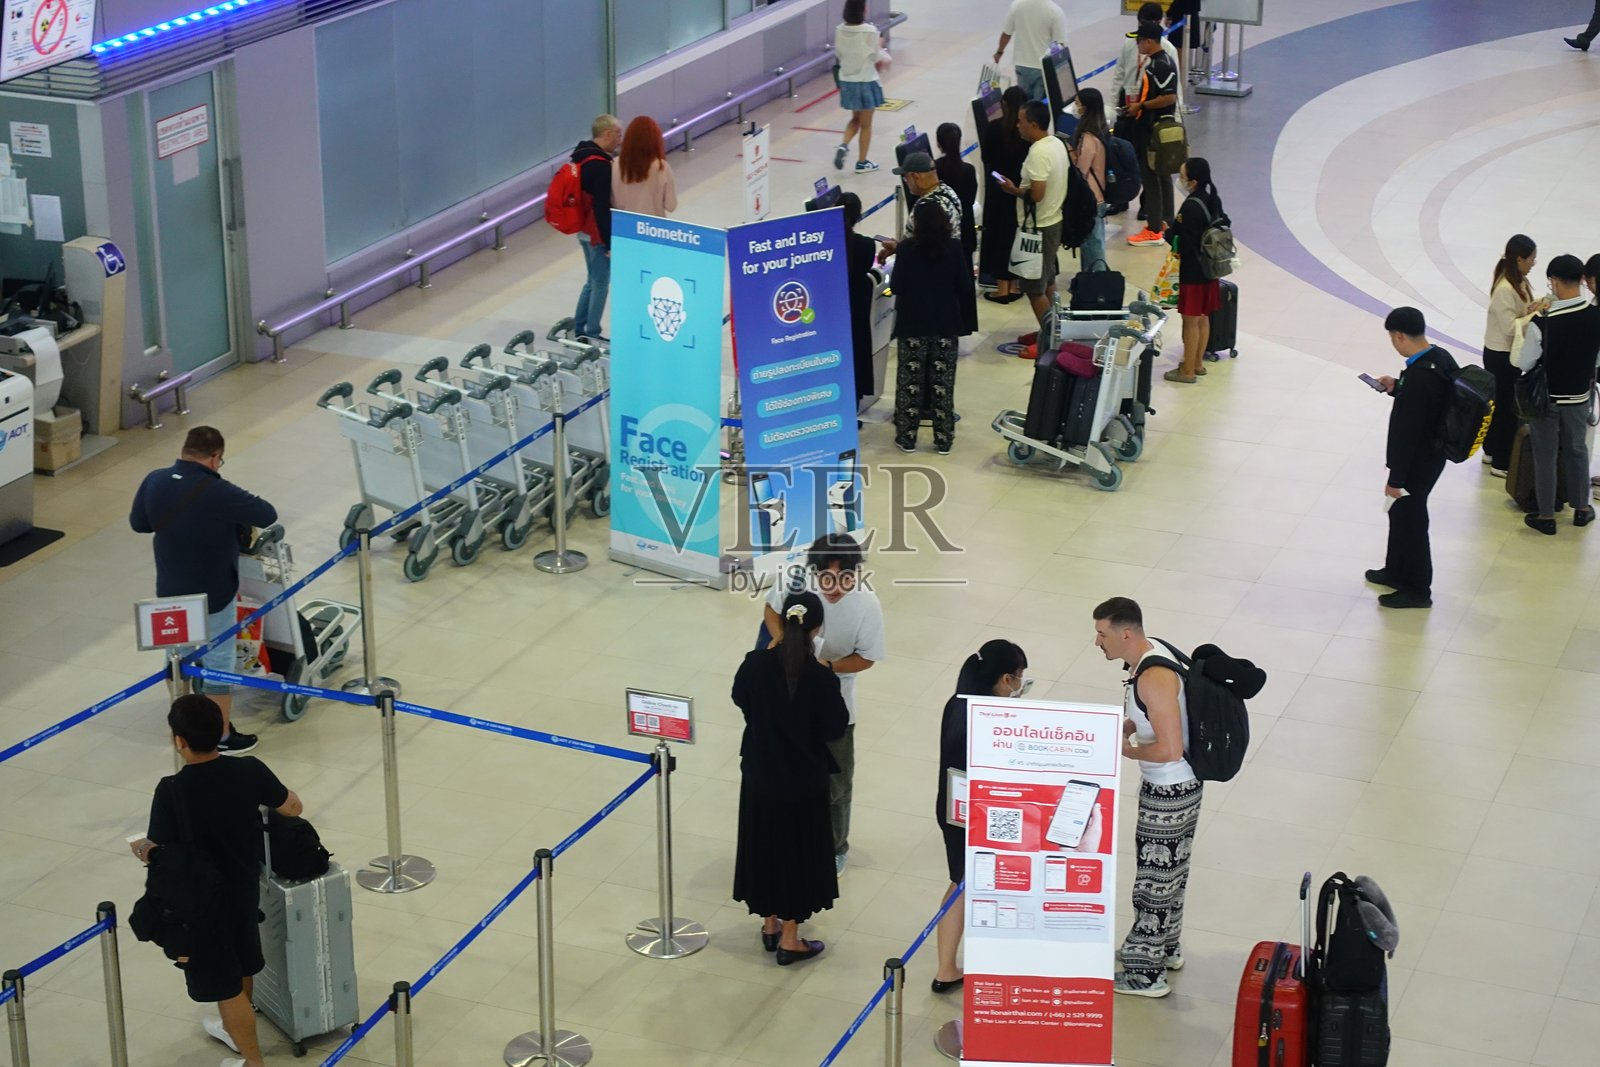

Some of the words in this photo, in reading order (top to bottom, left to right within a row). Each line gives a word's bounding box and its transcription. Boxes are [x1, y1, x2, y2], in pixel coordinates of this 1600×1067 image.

[636, 221, 701, 246] Biometric
[748, 240, 772, 254] Fast
[775, 236, 797, 249] and
[799, 230, 825, 246] Easy
[742, 262, 758, 275] for
[762, 257, 788, 275] your
[790, 248, 834, 270] journey
[9, 423, 29, 440] AOT
[620, 415, 687, 461] Face
[620, 450, 708, 484] Registration
[992, 725, 1095, 742] ออนไลน์เช็คอิน
[992, 739, 1013, 749] ผ่าน
[973, 1009, 1043, 1017] www.lionairthai.com
